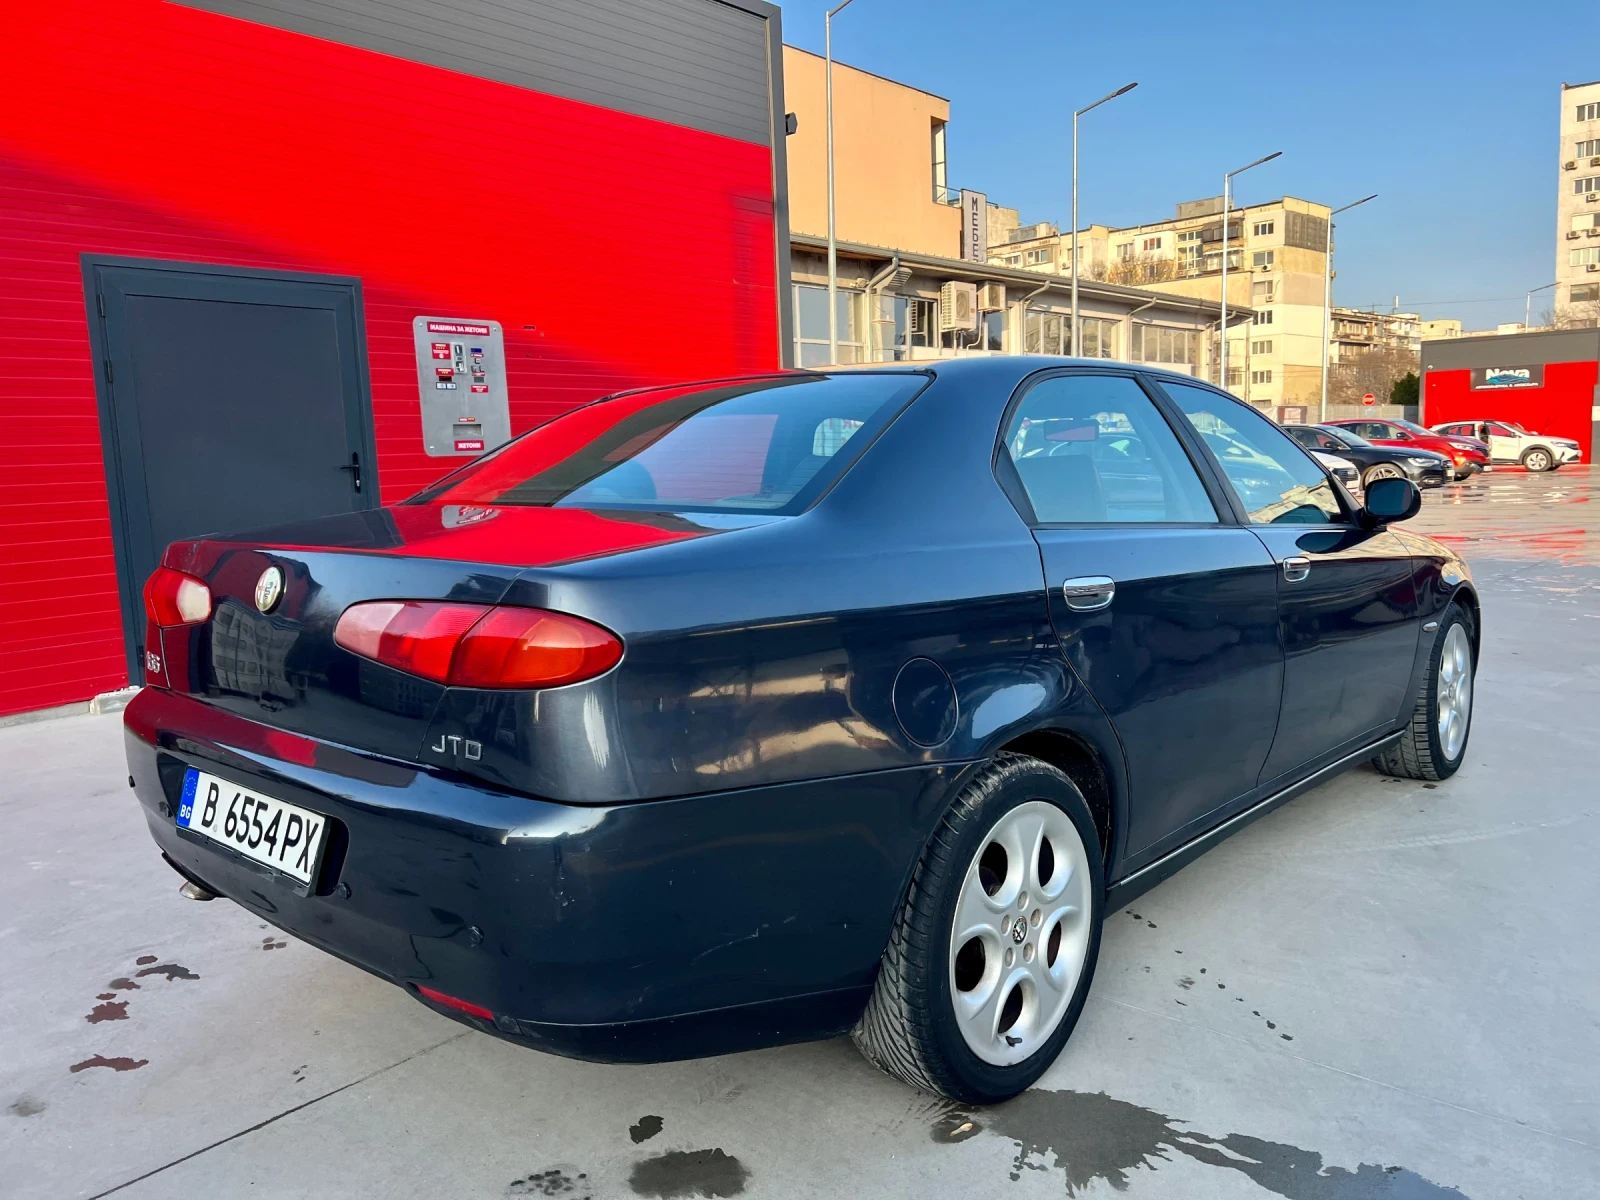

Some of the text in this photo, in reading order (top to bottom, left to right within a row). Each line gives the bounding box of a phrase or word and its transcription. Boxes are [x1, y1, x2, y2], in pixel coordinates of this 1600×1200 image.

[971, 196, 979, 262] МЕБЕ
[430, 324, 456, 332] МАШИНА
[464, 326, 488, 334] ЖЕТОНИ
[1485, 368, 1530, 380] Nova
[431, 735, 482, 760] JTD
[180, 804, 192, 819] BG
[201, 782, 220, 828] B
